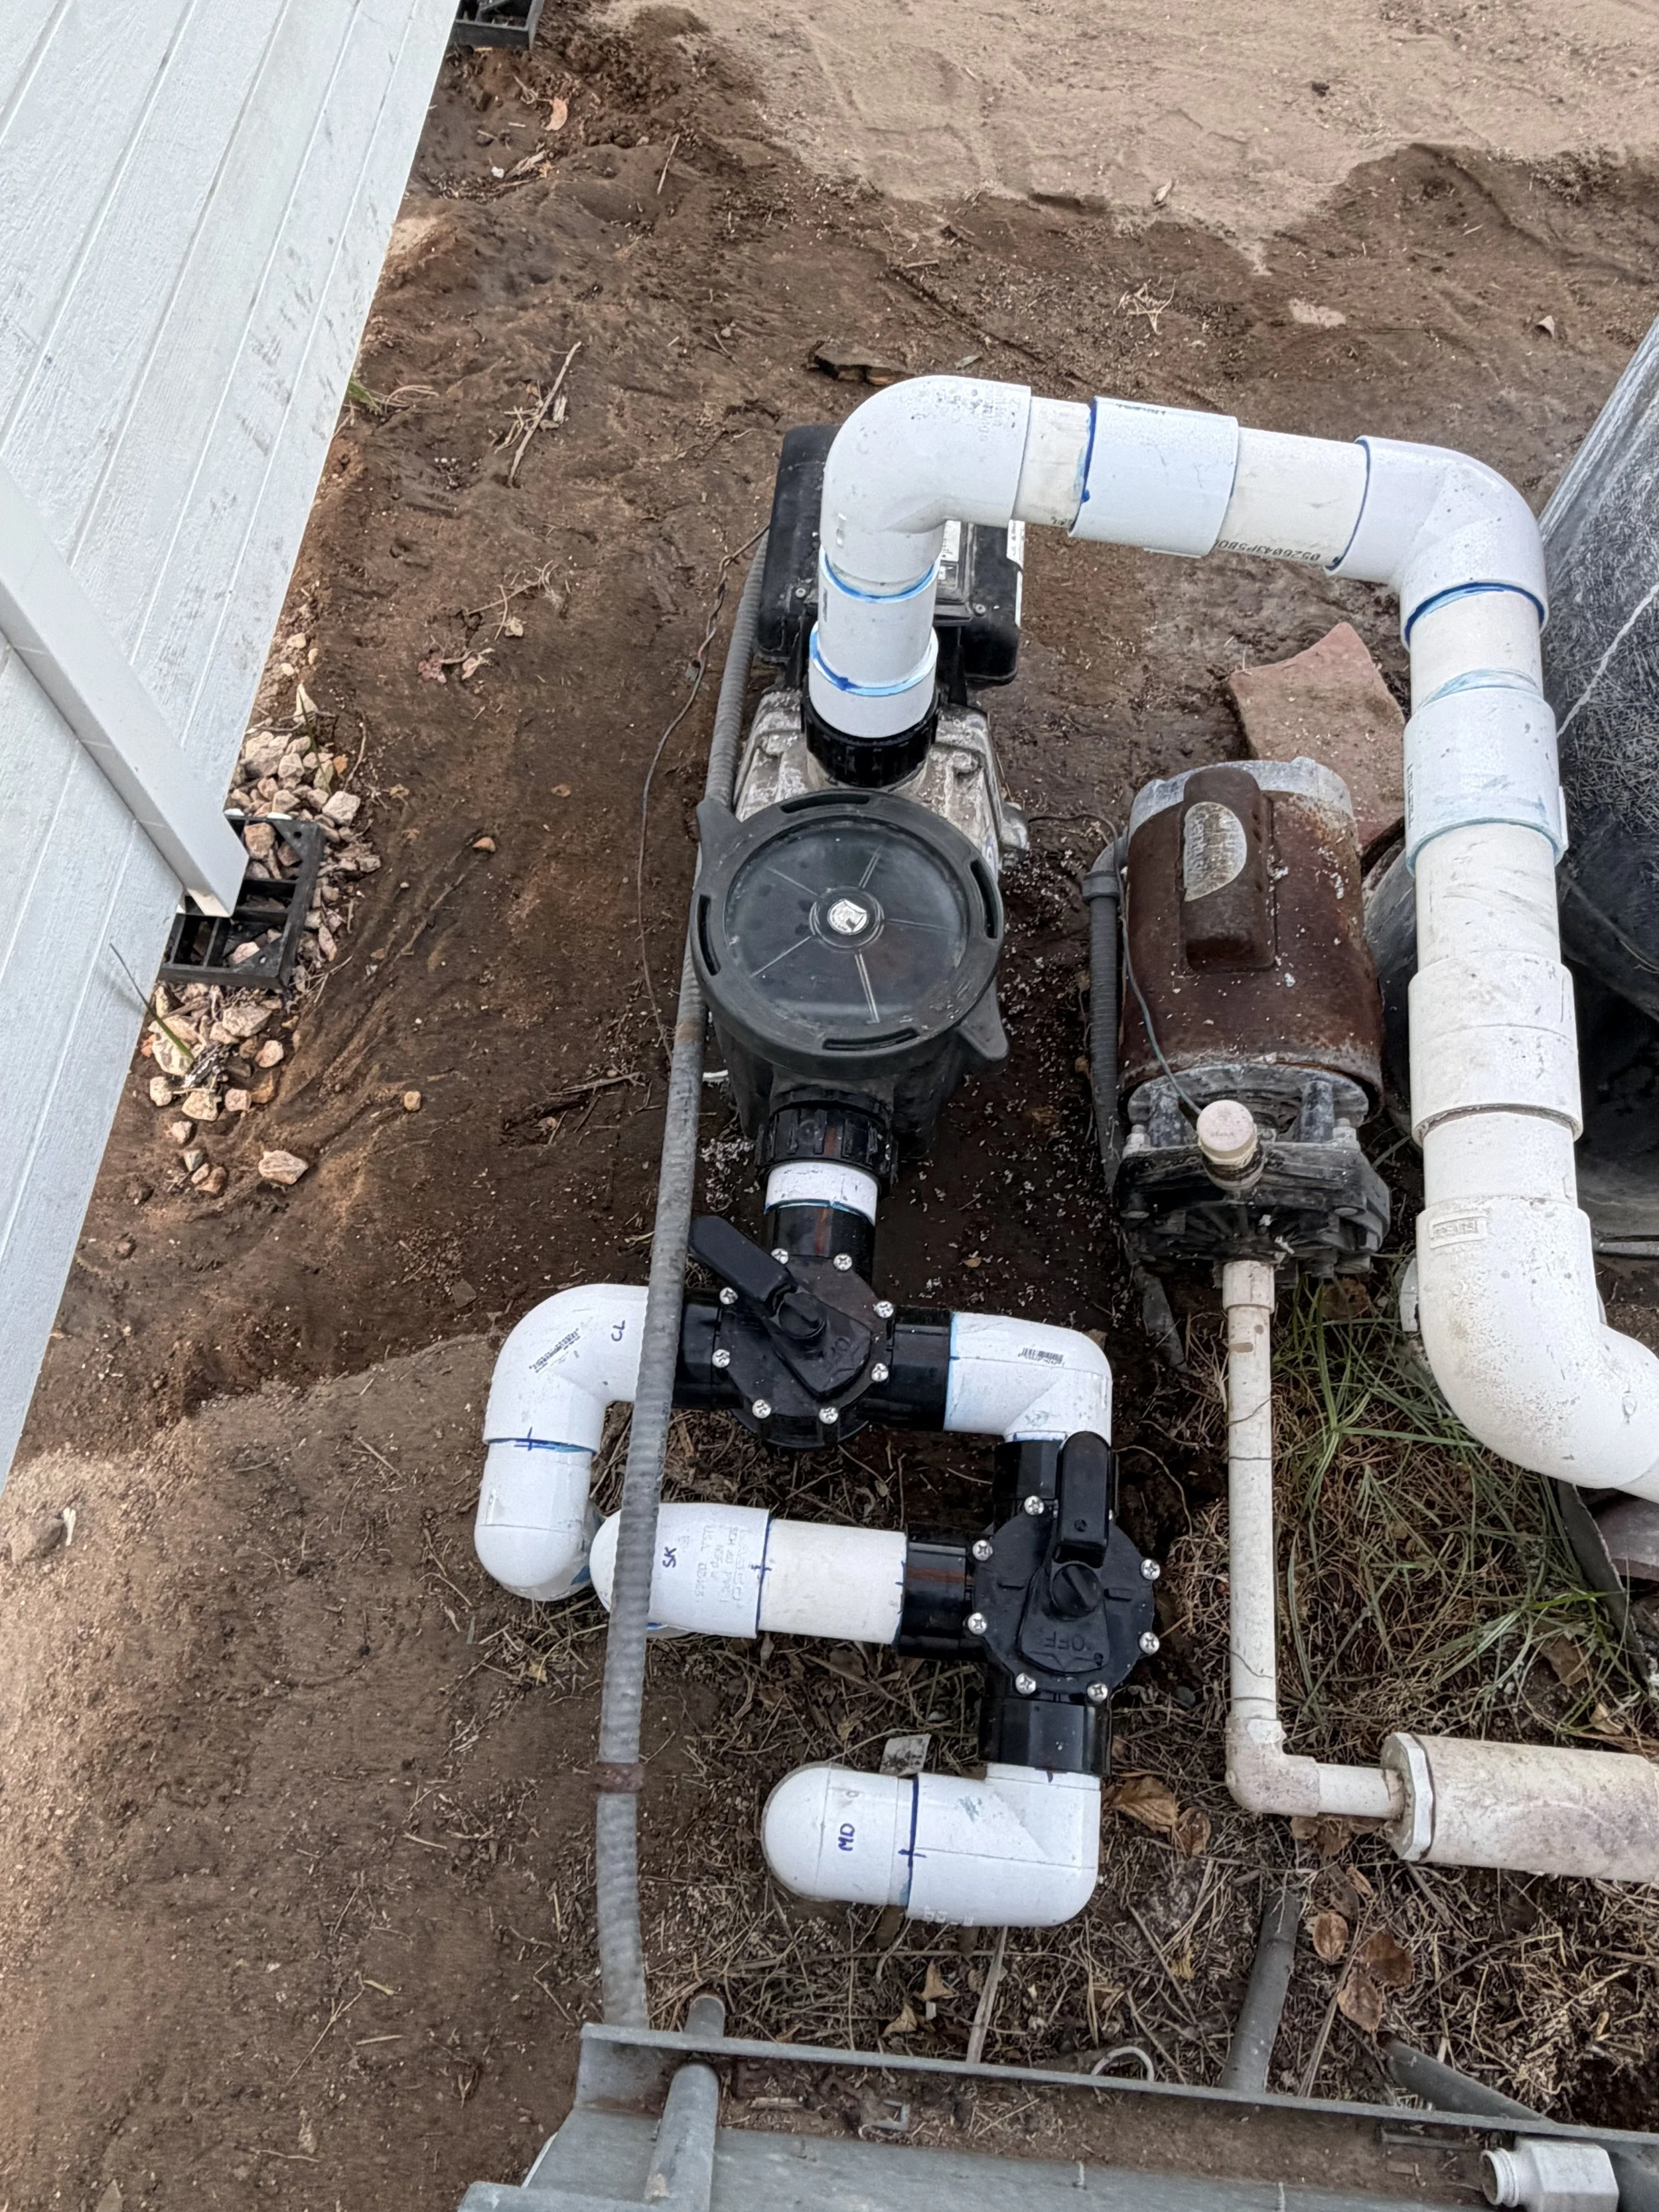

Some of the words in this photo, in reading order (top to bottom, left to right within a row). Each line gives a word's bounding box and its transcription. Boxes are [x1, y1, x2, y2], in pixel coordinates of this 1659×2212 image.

[611, 1320, 626, 1342] CL
[662, 1546, 677, 1568] SK
[1044, 1631, 1085, 1651] OFF
